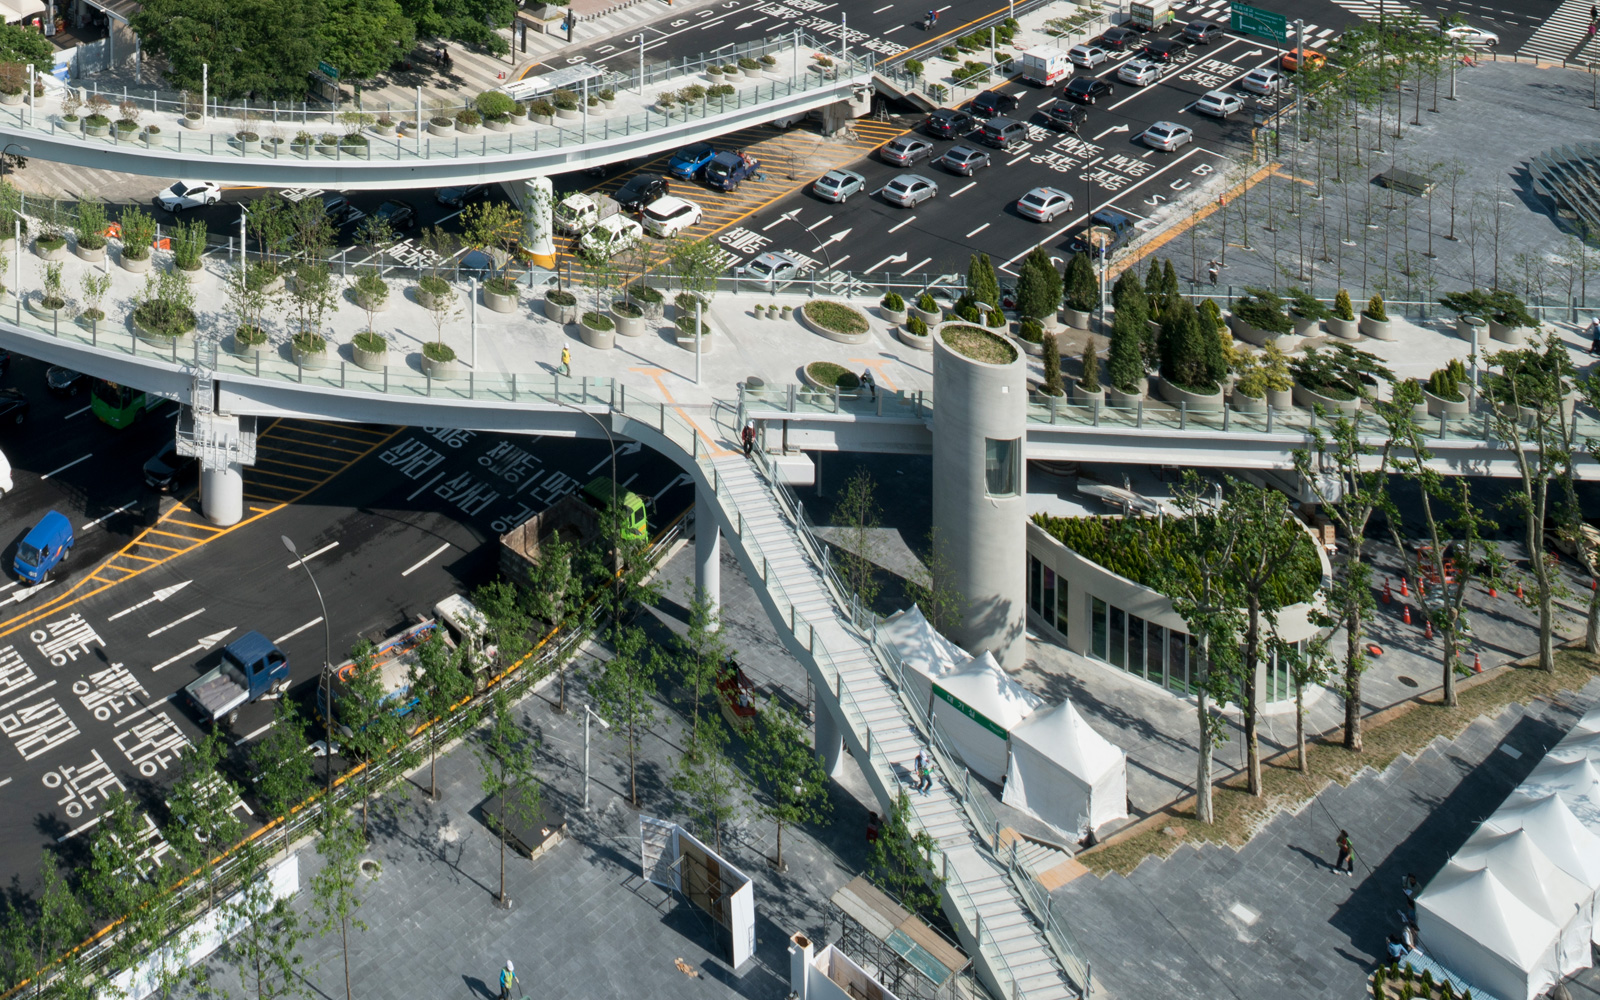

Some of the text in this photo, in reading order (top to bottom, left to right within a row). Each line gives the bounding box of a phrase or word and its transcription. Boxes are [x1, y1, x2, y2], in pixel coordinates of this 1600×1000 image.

[1179, 69, 1226, 88] 공덕동
[1197, 59, 1245, 77] 만리동
[1030, 149, 1082, 172] 공덕동
[1052, 137, 1104, 159] 만리동
[1079, 167, 1133, 191] 공덕동
[1102, 154, 1156, 177] 만리동
[718, 227, 774, 254] 청파동
[378, 437, 446, 480] 삼거리
[478, 440, 542, 482] 청파동
[434, 471, 500, 516] 삼거리
[30, 613, 106, 667] 청파동
[72, 662, 150, 721] 청파동
[113, 711, 197, 777] 만리동
[42, 749, 127, 818] 공덕동
